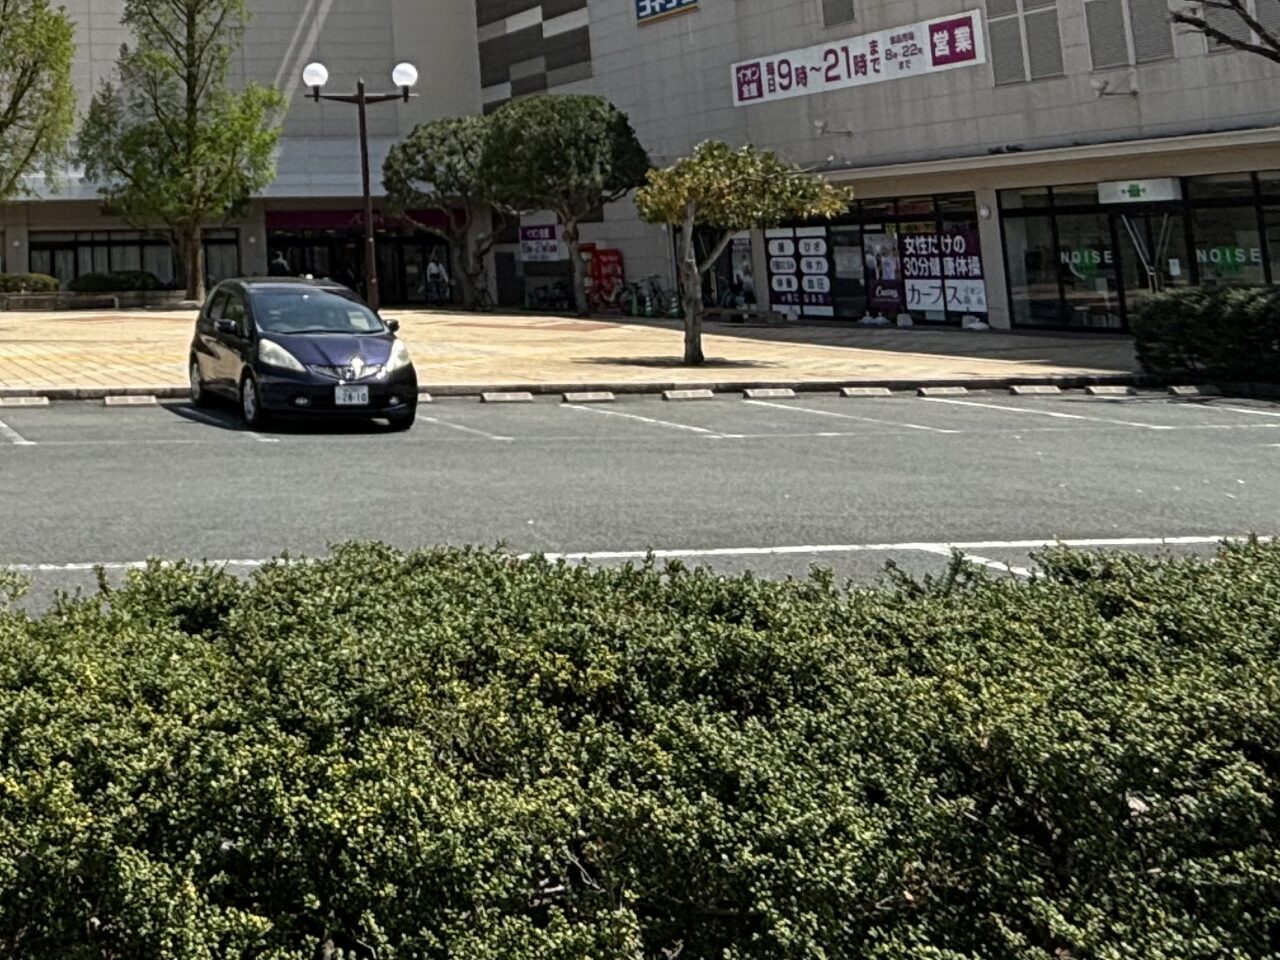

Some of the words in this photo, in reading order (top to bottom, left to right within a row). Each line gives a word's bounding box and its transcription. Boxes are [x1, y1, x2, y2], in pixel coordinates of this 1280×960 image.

[932, 25, 972, 57] 営業
[903, 234, 966, 255] 女性だけの
[1060, 249, 1113, 264] NOISE
[1196, 247, 1262, 263] NOISE
